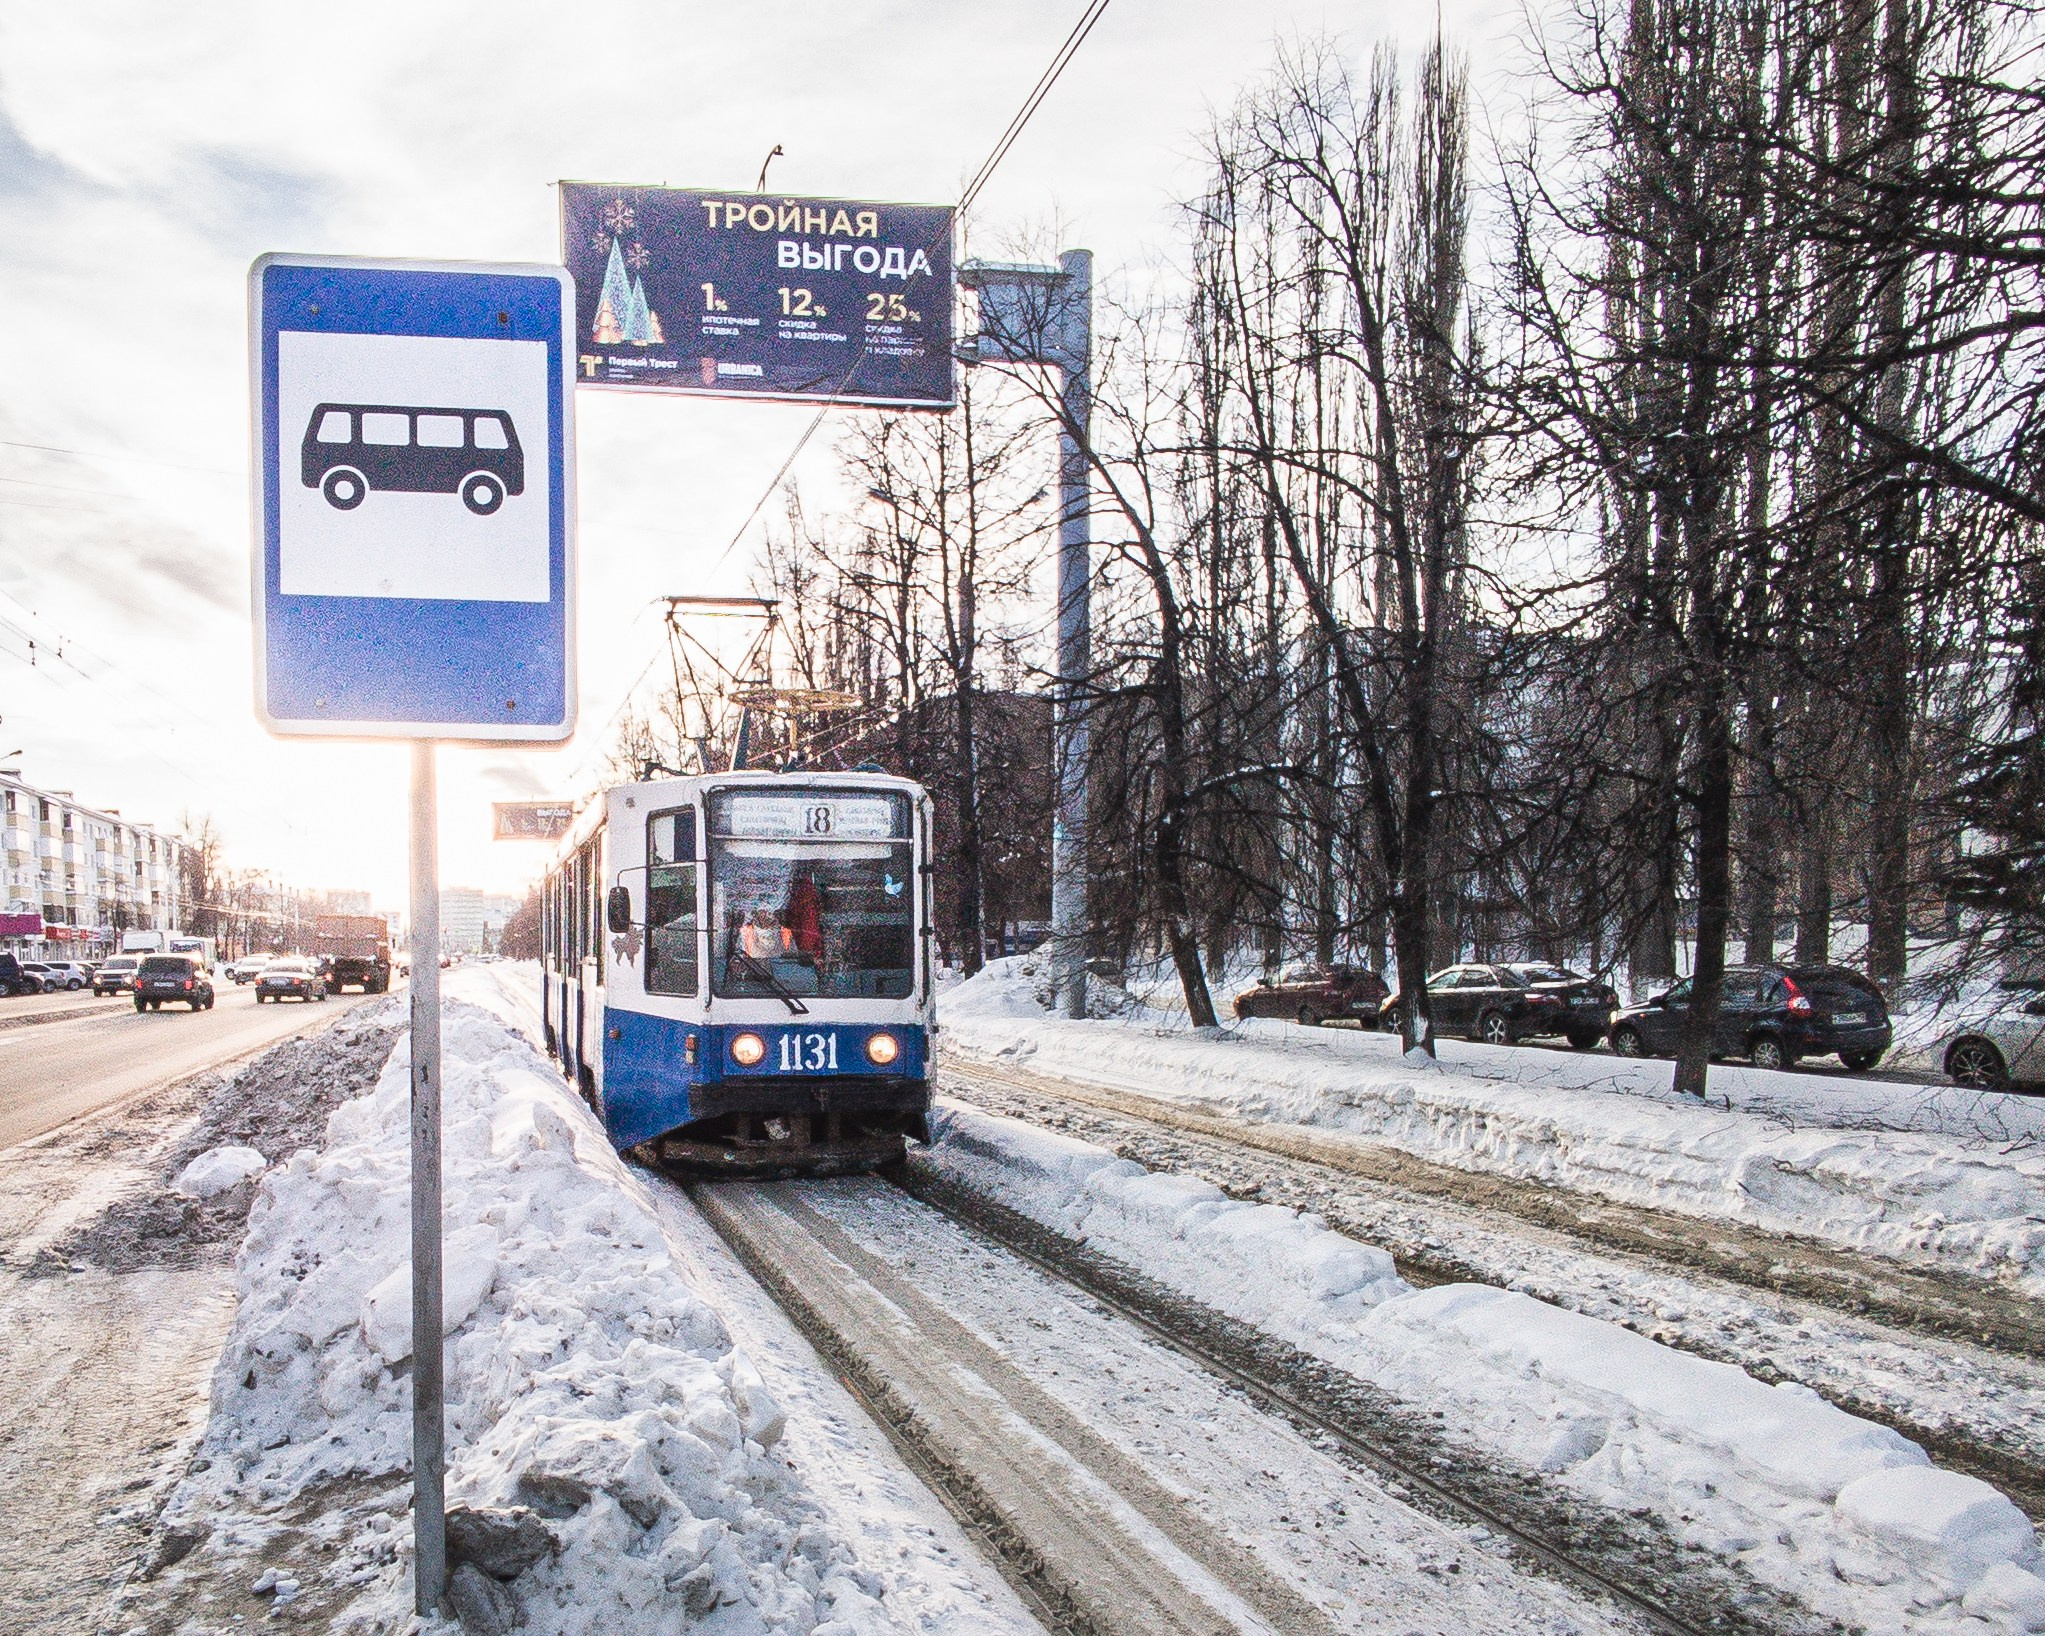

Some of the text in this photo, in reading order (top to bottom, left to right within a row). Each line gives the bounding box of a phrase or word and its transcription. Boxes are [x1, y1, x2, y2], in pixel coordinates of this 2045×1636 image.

[702, 199, 878, 238] ТРОЙНАЯ
[777, 240, 933, 280] ВЫГОДА
[701, 282, 728, 312] 1%
[778, 287, 827, 317] 12%
[866, 292, 921, 322] 25%
[702, 315, 760, 326] ипотечная
[702, 326, 740, 336] ставка
[778, 320, 817, 330] скидка
[778, 331, 847, 342] на квартиры
[609, 356, 678, 369] Первый Трест
[804, 806, 831, 834] 18
[778, 1033, 838, 1071] 1131
